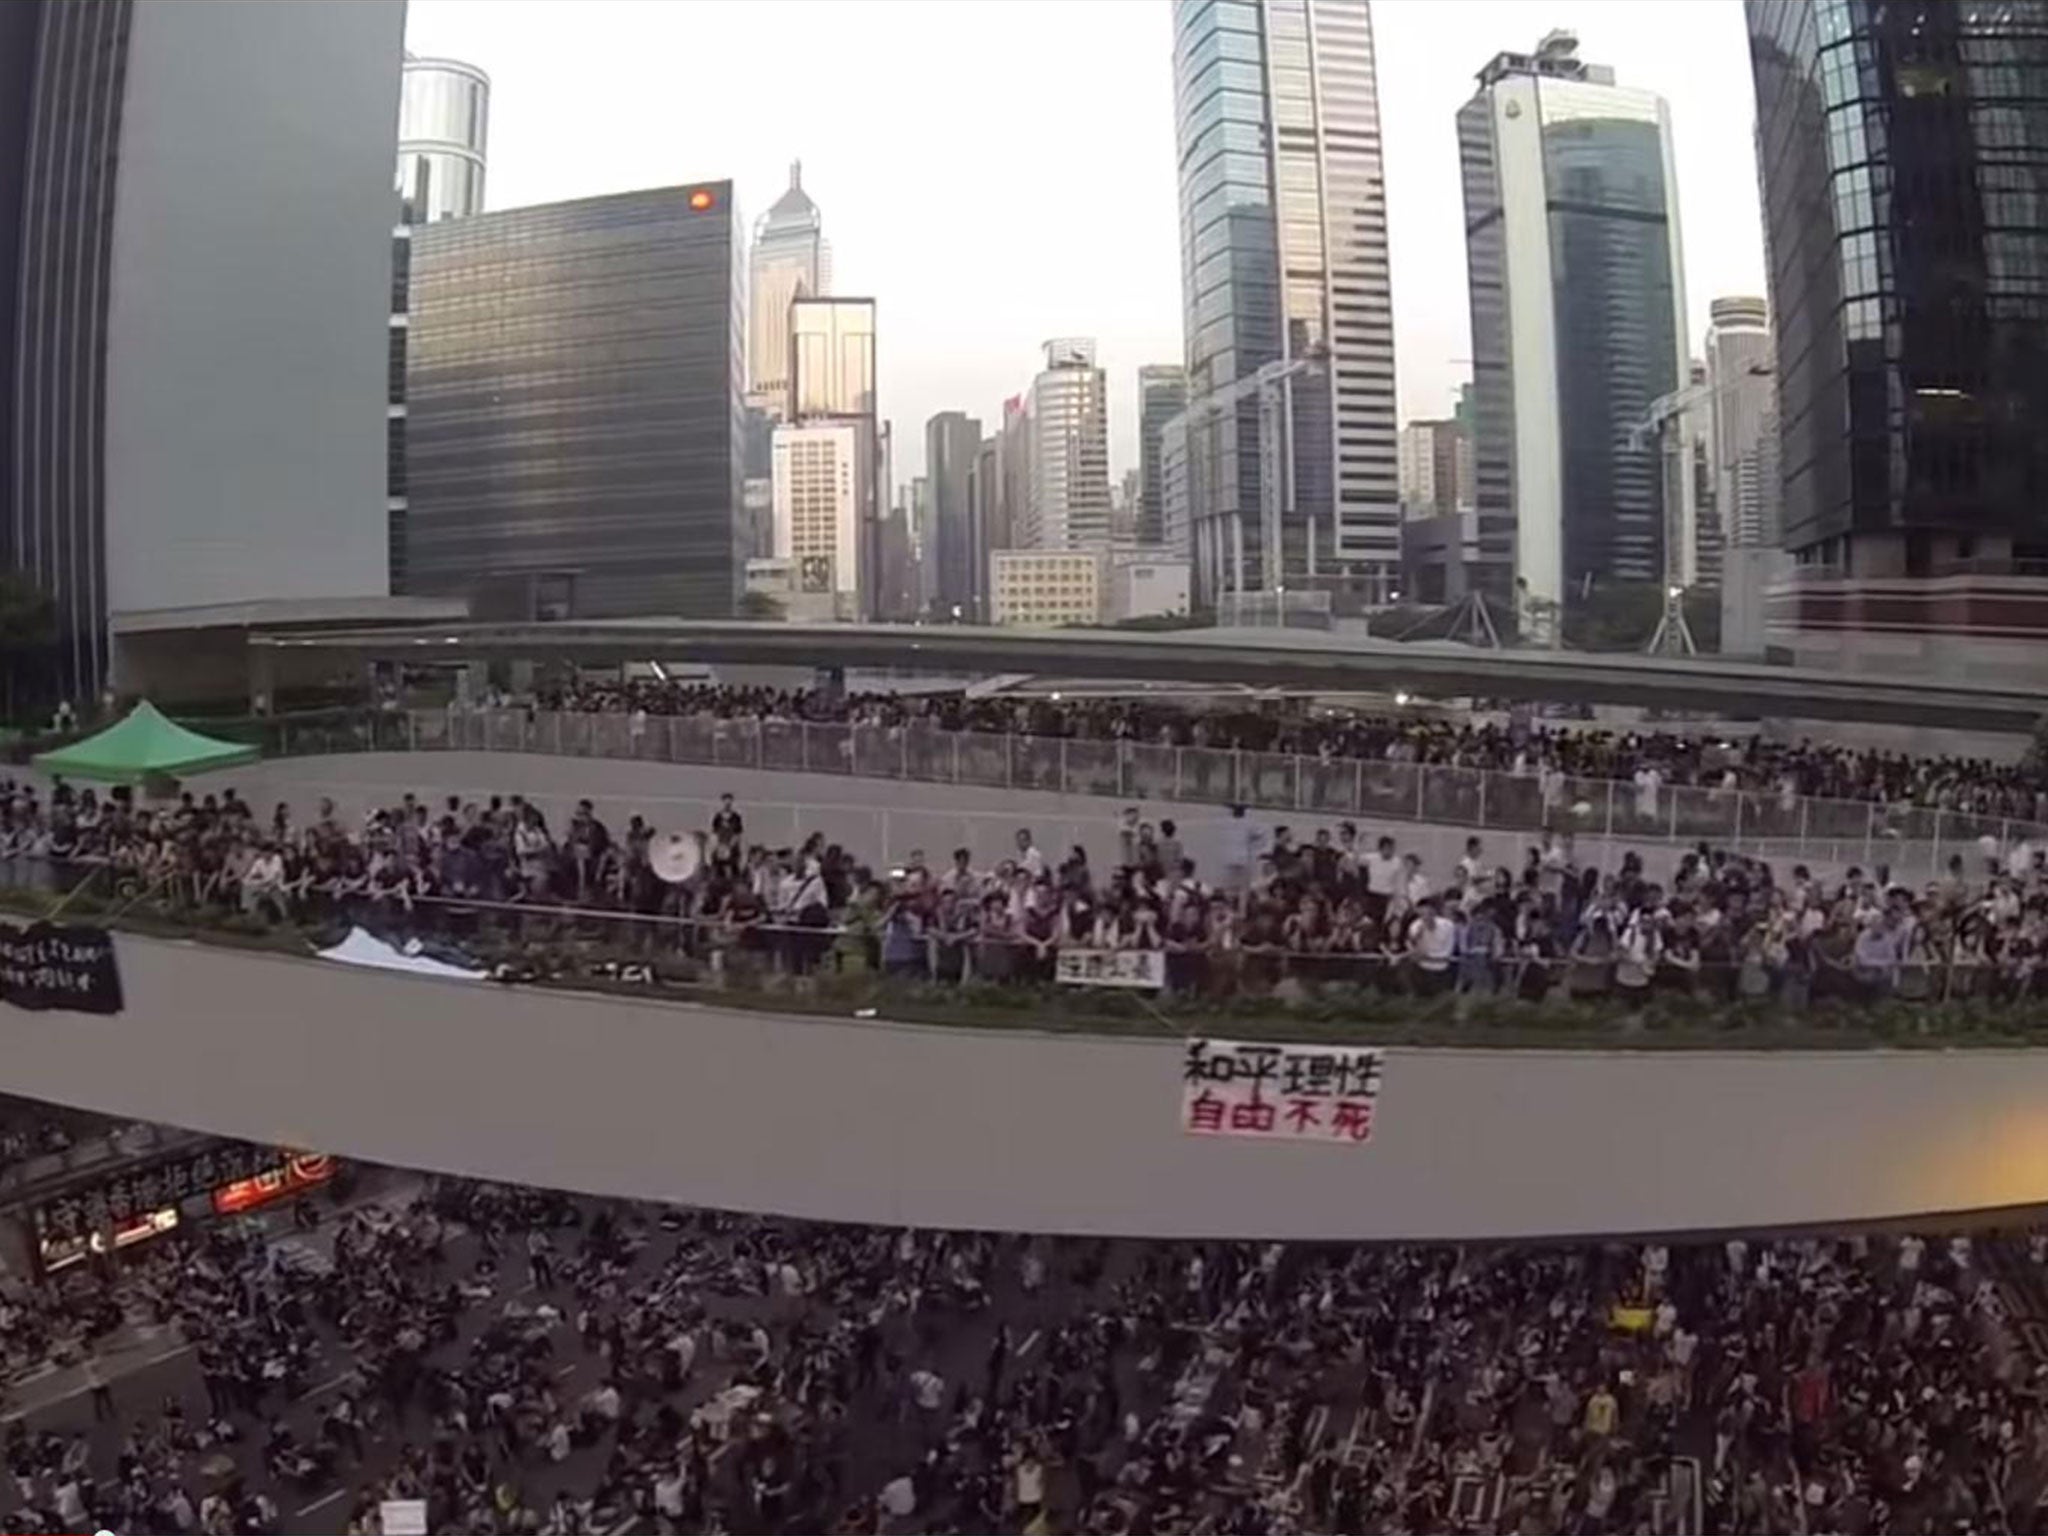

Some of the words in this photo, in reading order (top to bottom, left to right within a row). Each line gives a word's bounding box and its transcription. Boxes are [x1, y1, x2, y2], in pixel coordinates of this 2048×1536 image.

[1184, 1041, 1384, 1097] 和平理性
[1189, 1090, 1371, 1141] 自由不死
